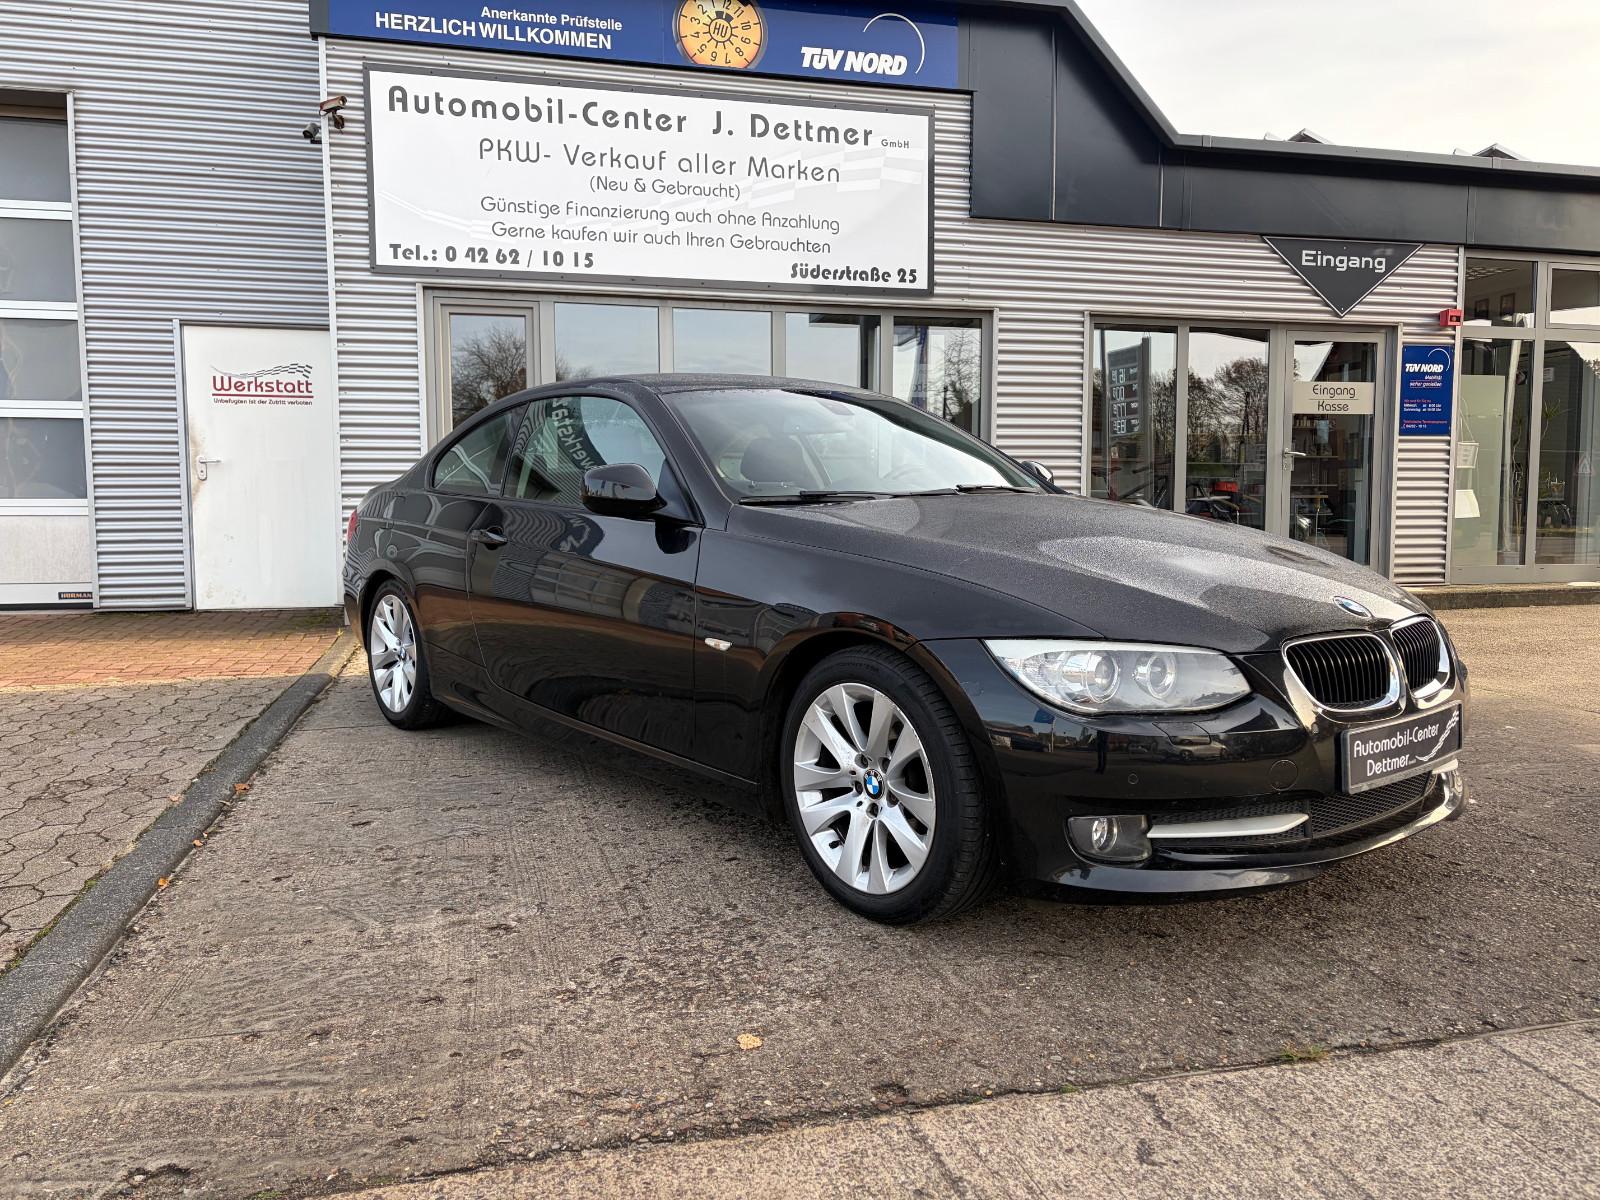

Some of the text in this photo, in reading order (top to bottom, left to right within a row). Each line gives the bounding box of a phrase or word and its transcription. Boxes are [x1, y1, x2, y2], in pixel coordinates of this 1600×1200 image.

[481, 6, 623, 31] Anerkannte Prüfstelle
[690, 16, 700, 25] 3
[697, 4, 708, 15] 2
[734, 6, 744, 18] 11
[375, 11, 612, 50] HERZLICH WILLKOMMEN
[712, 22, 728, 38] HU
[740, 21, 752, 30] 10
[800, 46, 908, 76] TÜV NORD
[388, 85, 910, 149] Automobil-Center J. Dettmer GmbH
[479, 138, 840, 182] PKW- Verkauf aller Marken
[590, 175, 741, 201] (Neu & Gebraucht)
[481, 196, 840, 234] Günstige Finanzierung auch ohne Anzahlung
[492, 222, 831, 254] Gerne kaufen wir auch Ihren Gebrauchten
[389, 243, 594, 268] Tel.: 0 42 62 / 10 15
[1302, 250, 1386, 273] Eingang
[790, 263, 917, 284] Süderstraße 25
[1405, 363, 1444, 373] TÜV NORD
[212, 375, 313, 393] Werkstatt
[1312, 384, 1356, 399] Eingang
[1317, 401, 1349, 413] Kasse
[1353, 724, 1440, 758] Automobil-Center
[1367, 754, 1410, 777] Dettmer
